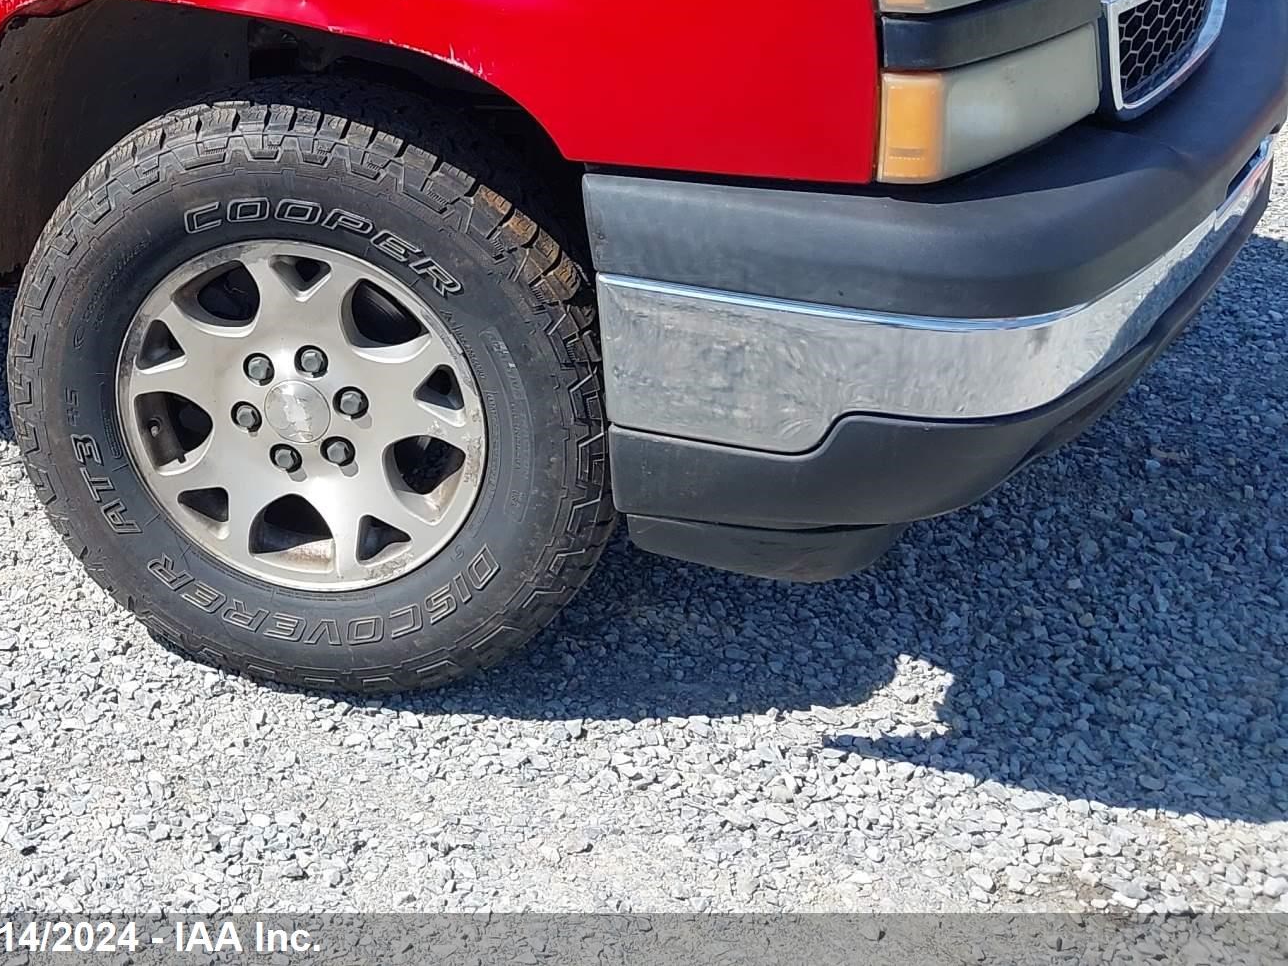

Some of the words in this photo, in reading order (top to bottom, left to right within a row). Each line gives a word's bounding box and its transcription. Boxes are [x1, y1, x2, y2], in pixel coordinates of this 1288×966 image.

[184, 197, 464, 298] COOPER
[71, 434, 143, 535] AT3
[147, 542, 502, 646] DISCOVERER
